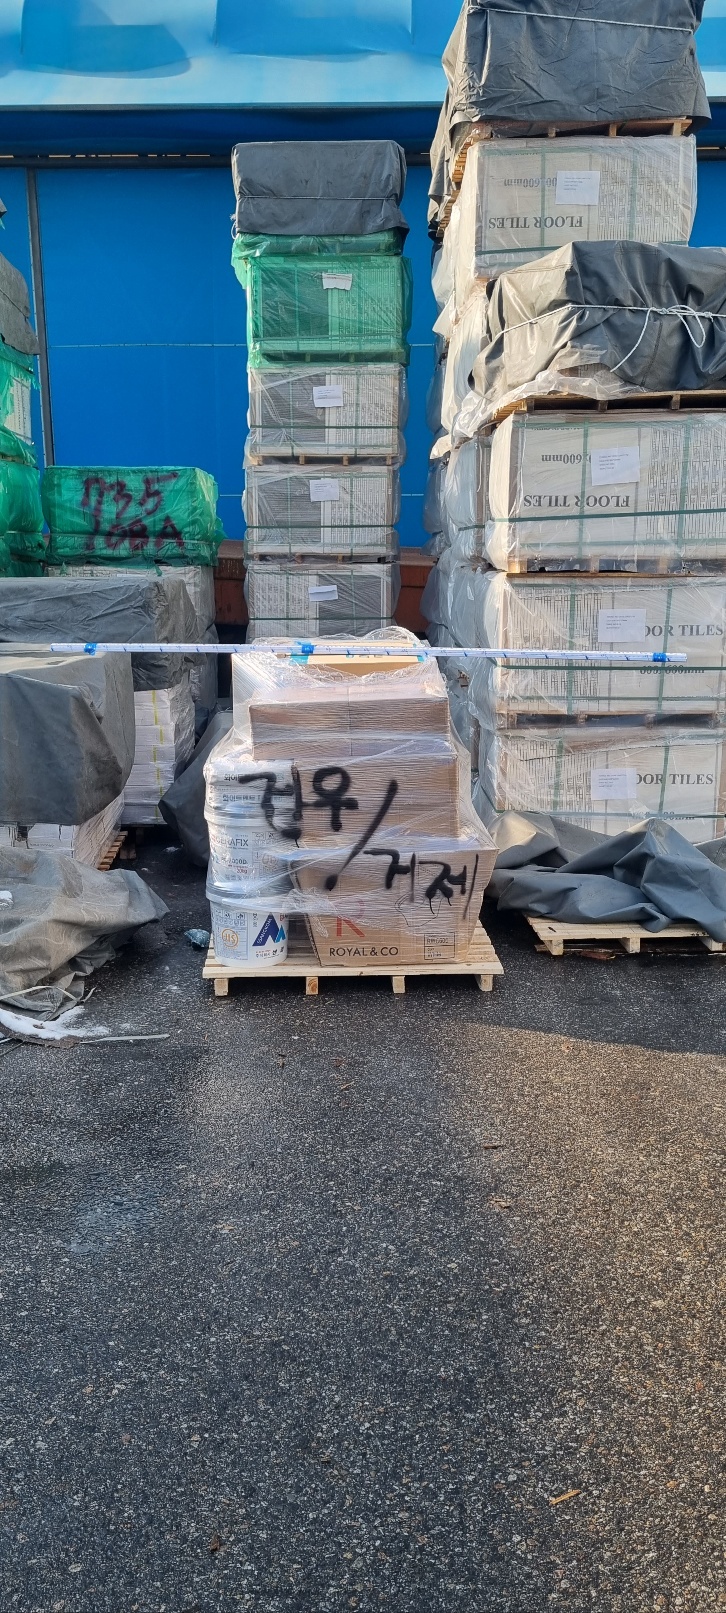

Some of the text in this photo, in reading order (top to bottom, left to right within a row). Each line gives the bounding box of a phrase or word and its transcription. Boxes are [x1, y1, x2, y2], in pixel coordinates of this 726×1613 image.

[488, 215, 584, 230] FLOOR TILES
[523, 494, 631, 508] FLOOR TILES
[645, 624, 724, 637] OOR TILES
[636, 773, 664, 785] OOR
[669, 773, 714, 785] TILES
[363, 848, 479, 920] 거제
[329, 946, 368, 957] ROYAL
[380, 946, 399, 956] CO
